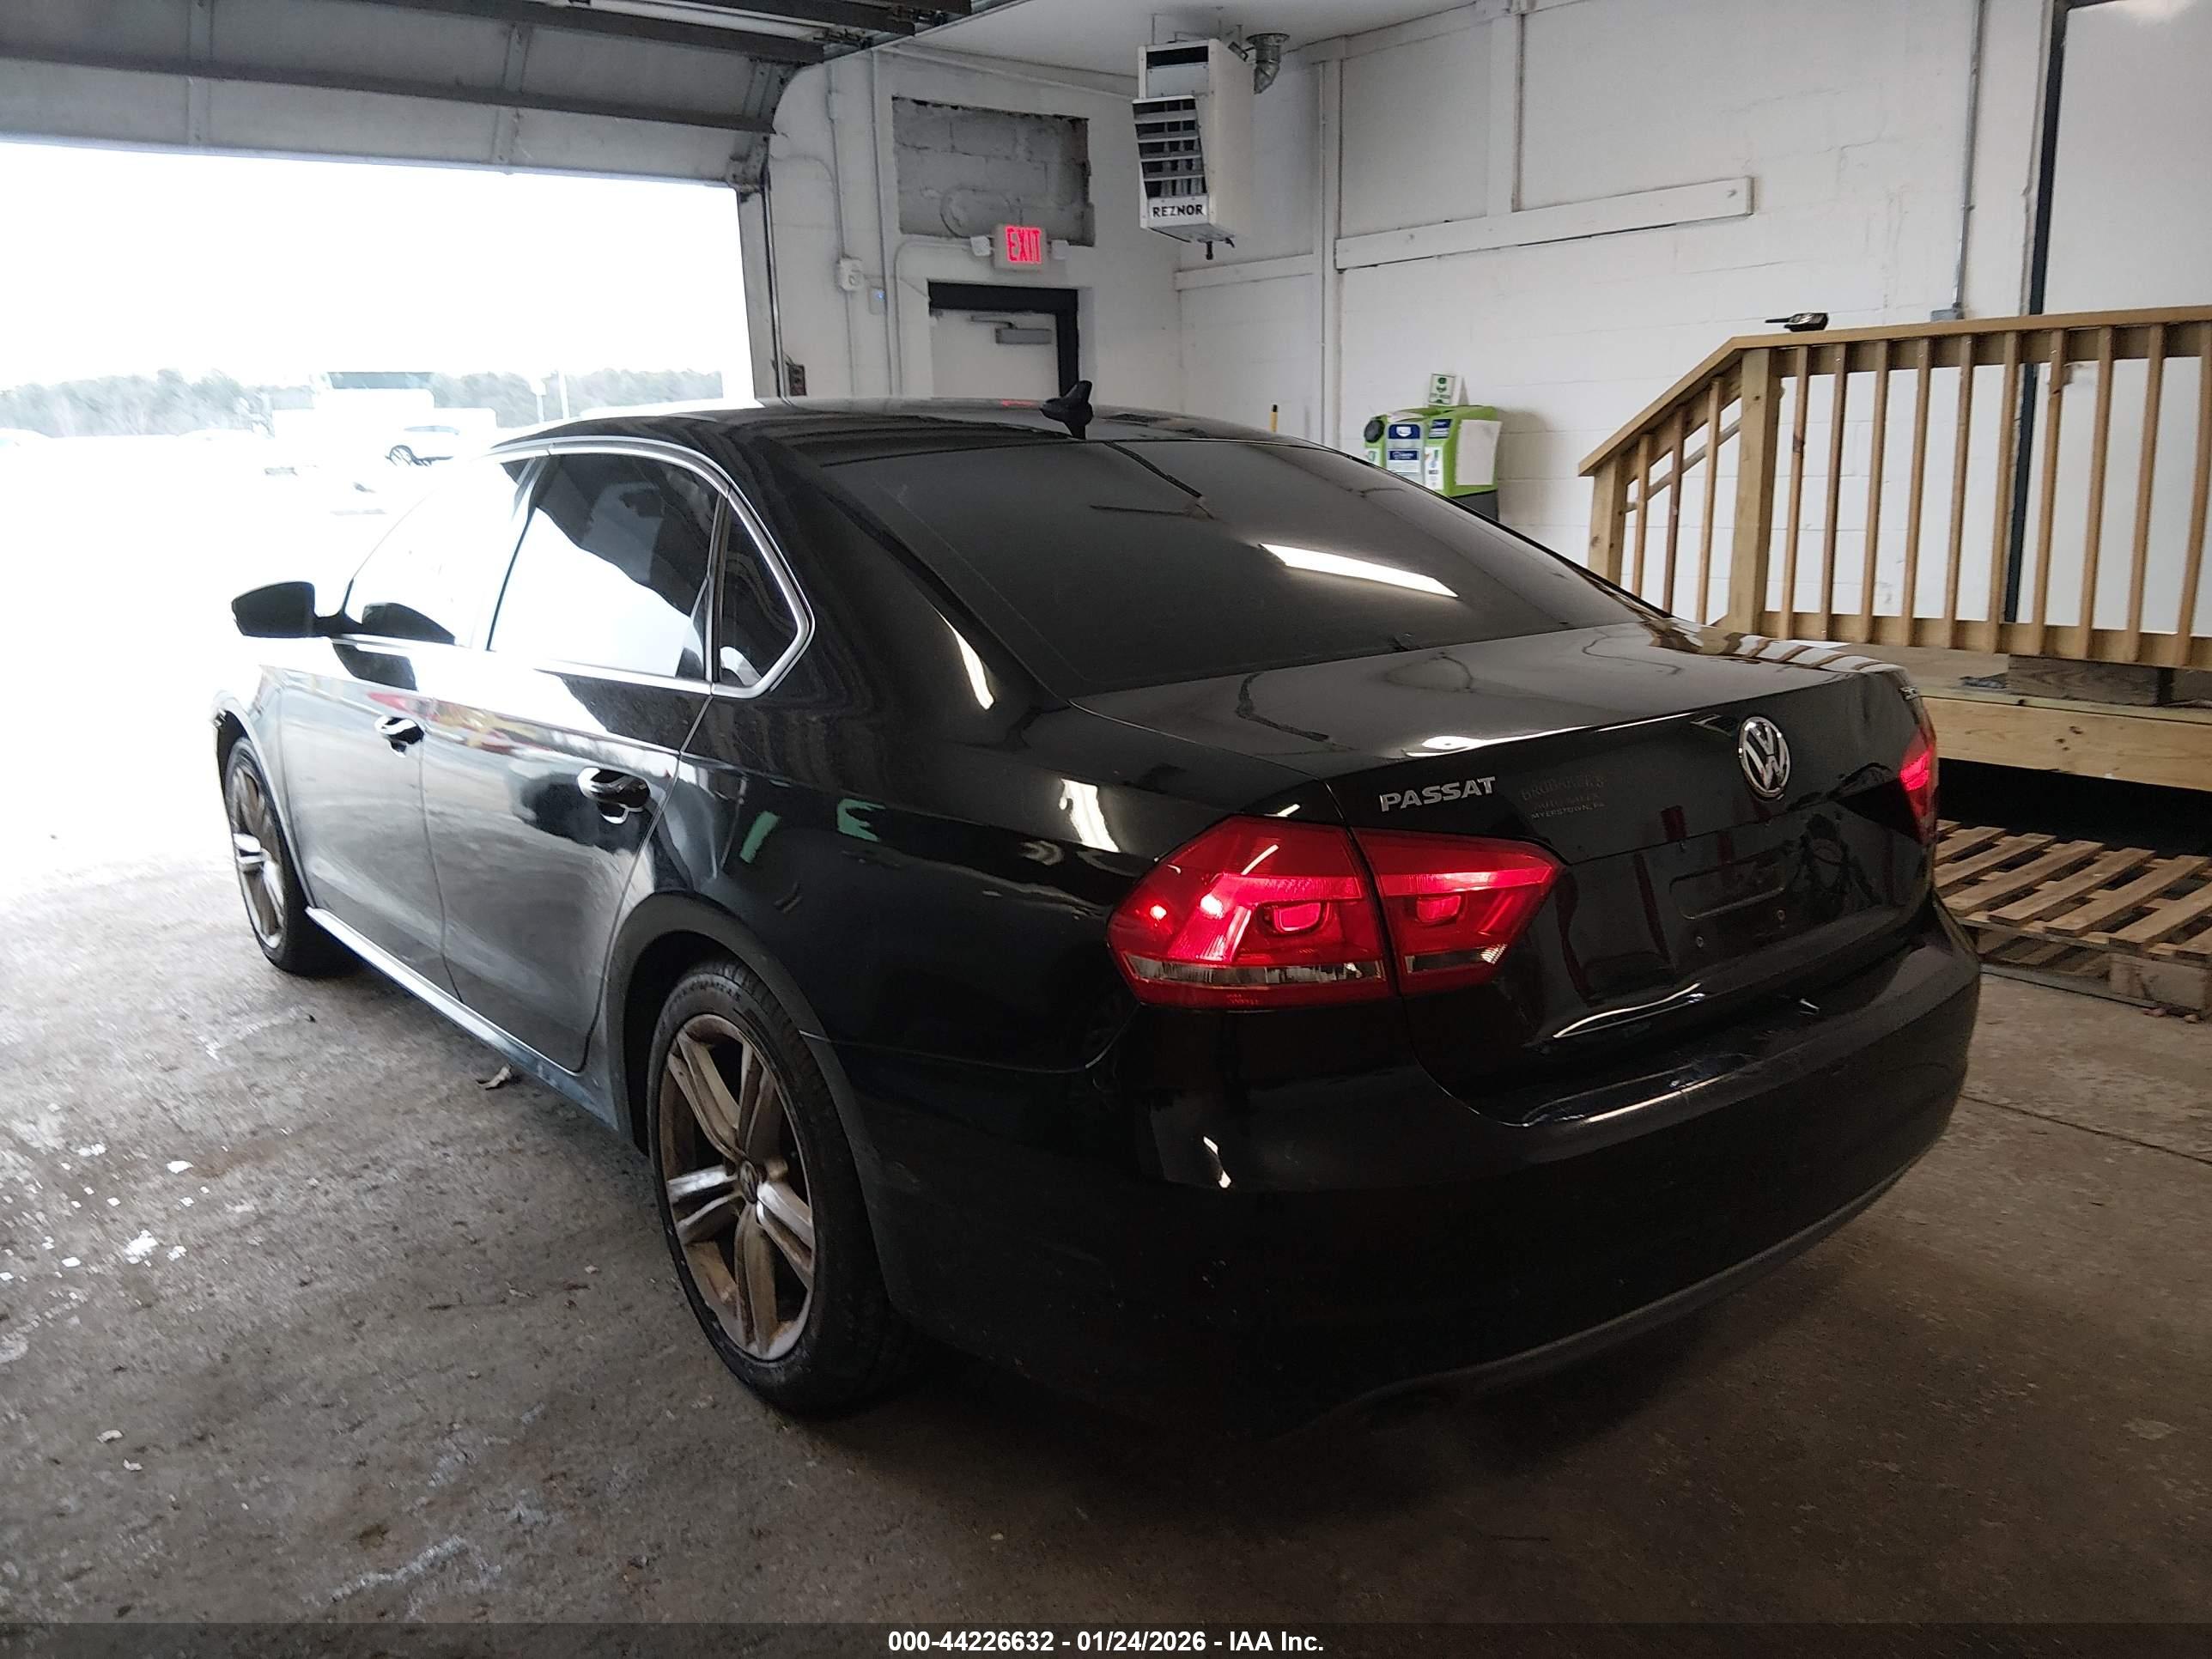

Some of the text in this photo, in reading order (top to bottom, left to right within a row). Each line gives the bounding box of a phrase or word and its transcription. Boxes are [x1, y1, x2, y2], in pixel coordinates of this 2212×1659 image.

[1152, 204, 1204, 217] REZNOR
[1006, 226, 1042, 264] EXIT
[1379, 776, 1496, 812] PASSAT
